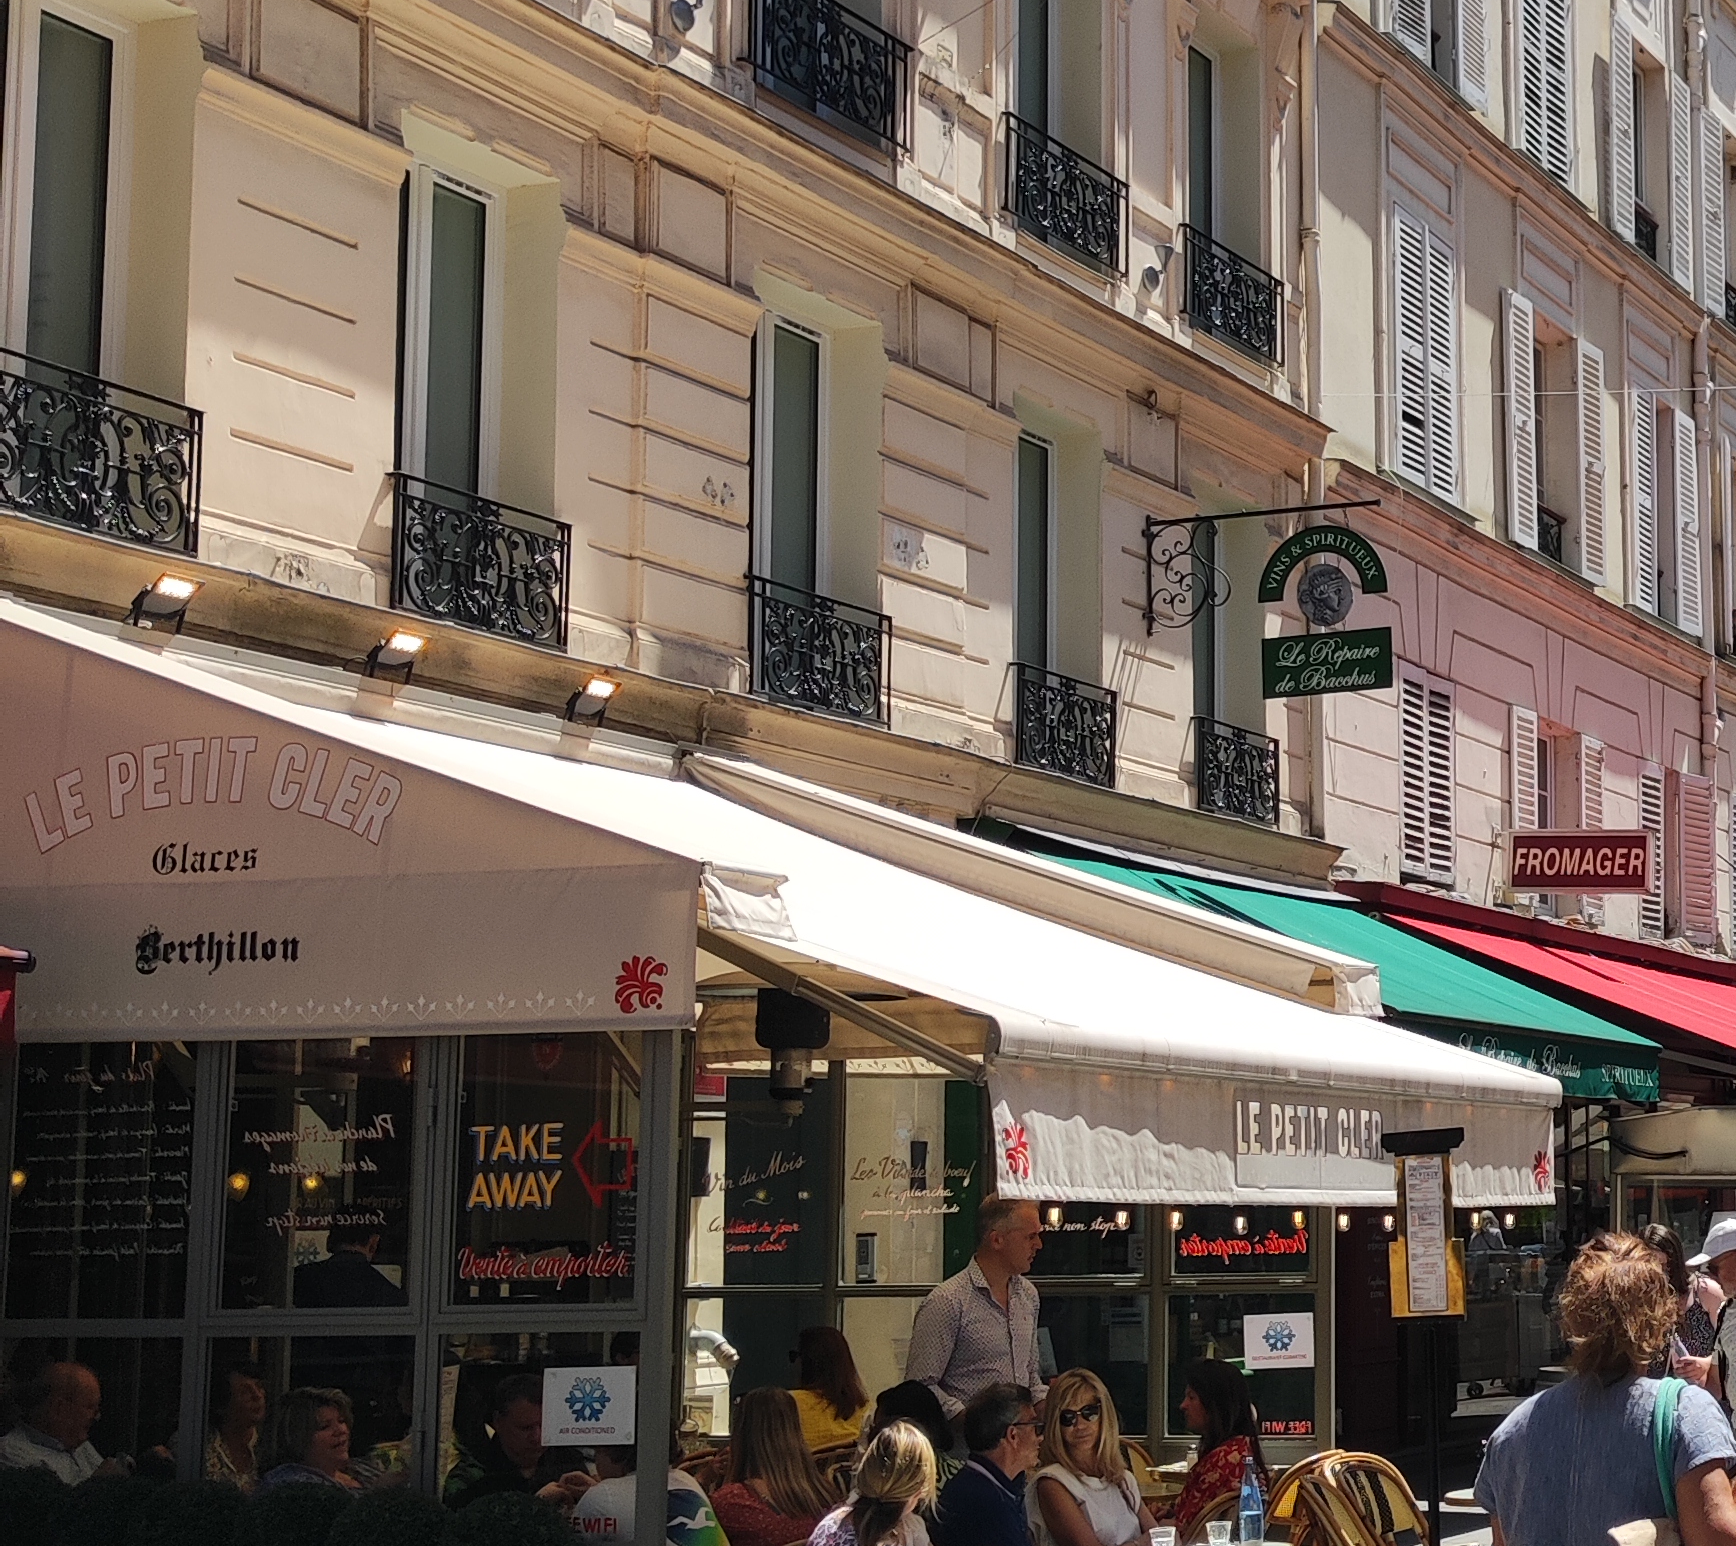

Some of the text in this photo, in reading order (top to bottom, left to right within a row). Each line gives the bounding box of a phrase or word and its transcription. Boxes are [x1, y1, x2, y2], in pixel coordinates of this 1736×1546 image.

[1266, 532, 1380, 590] VINS & SPIRITUEUX
[1275, 637, 1381, 671] Le Repaire
[1275, 665, 1377, 695] de Bacchus
[23, 735, 404, 855] LE PETIT CLER
[151, 840, 260, 876] Glaces
[1513, 846, 1646, 877] FROMAGER
[467, 1121, 565, 1165] TAKE
[1236, 1099, 1384, 1160] LE PETIT CLER
[702, 1150, 808, 1193] Vin du Mois
[849, 1156, 878, 1181] Les
[465, 1169, 564, 1213] AWAY
[1063, 1221, 1086, 1232] non
[457, 1240, 630, 1291] Vente à emporter
[559, 1426, 616, 1435] AIR CONDITIONED
